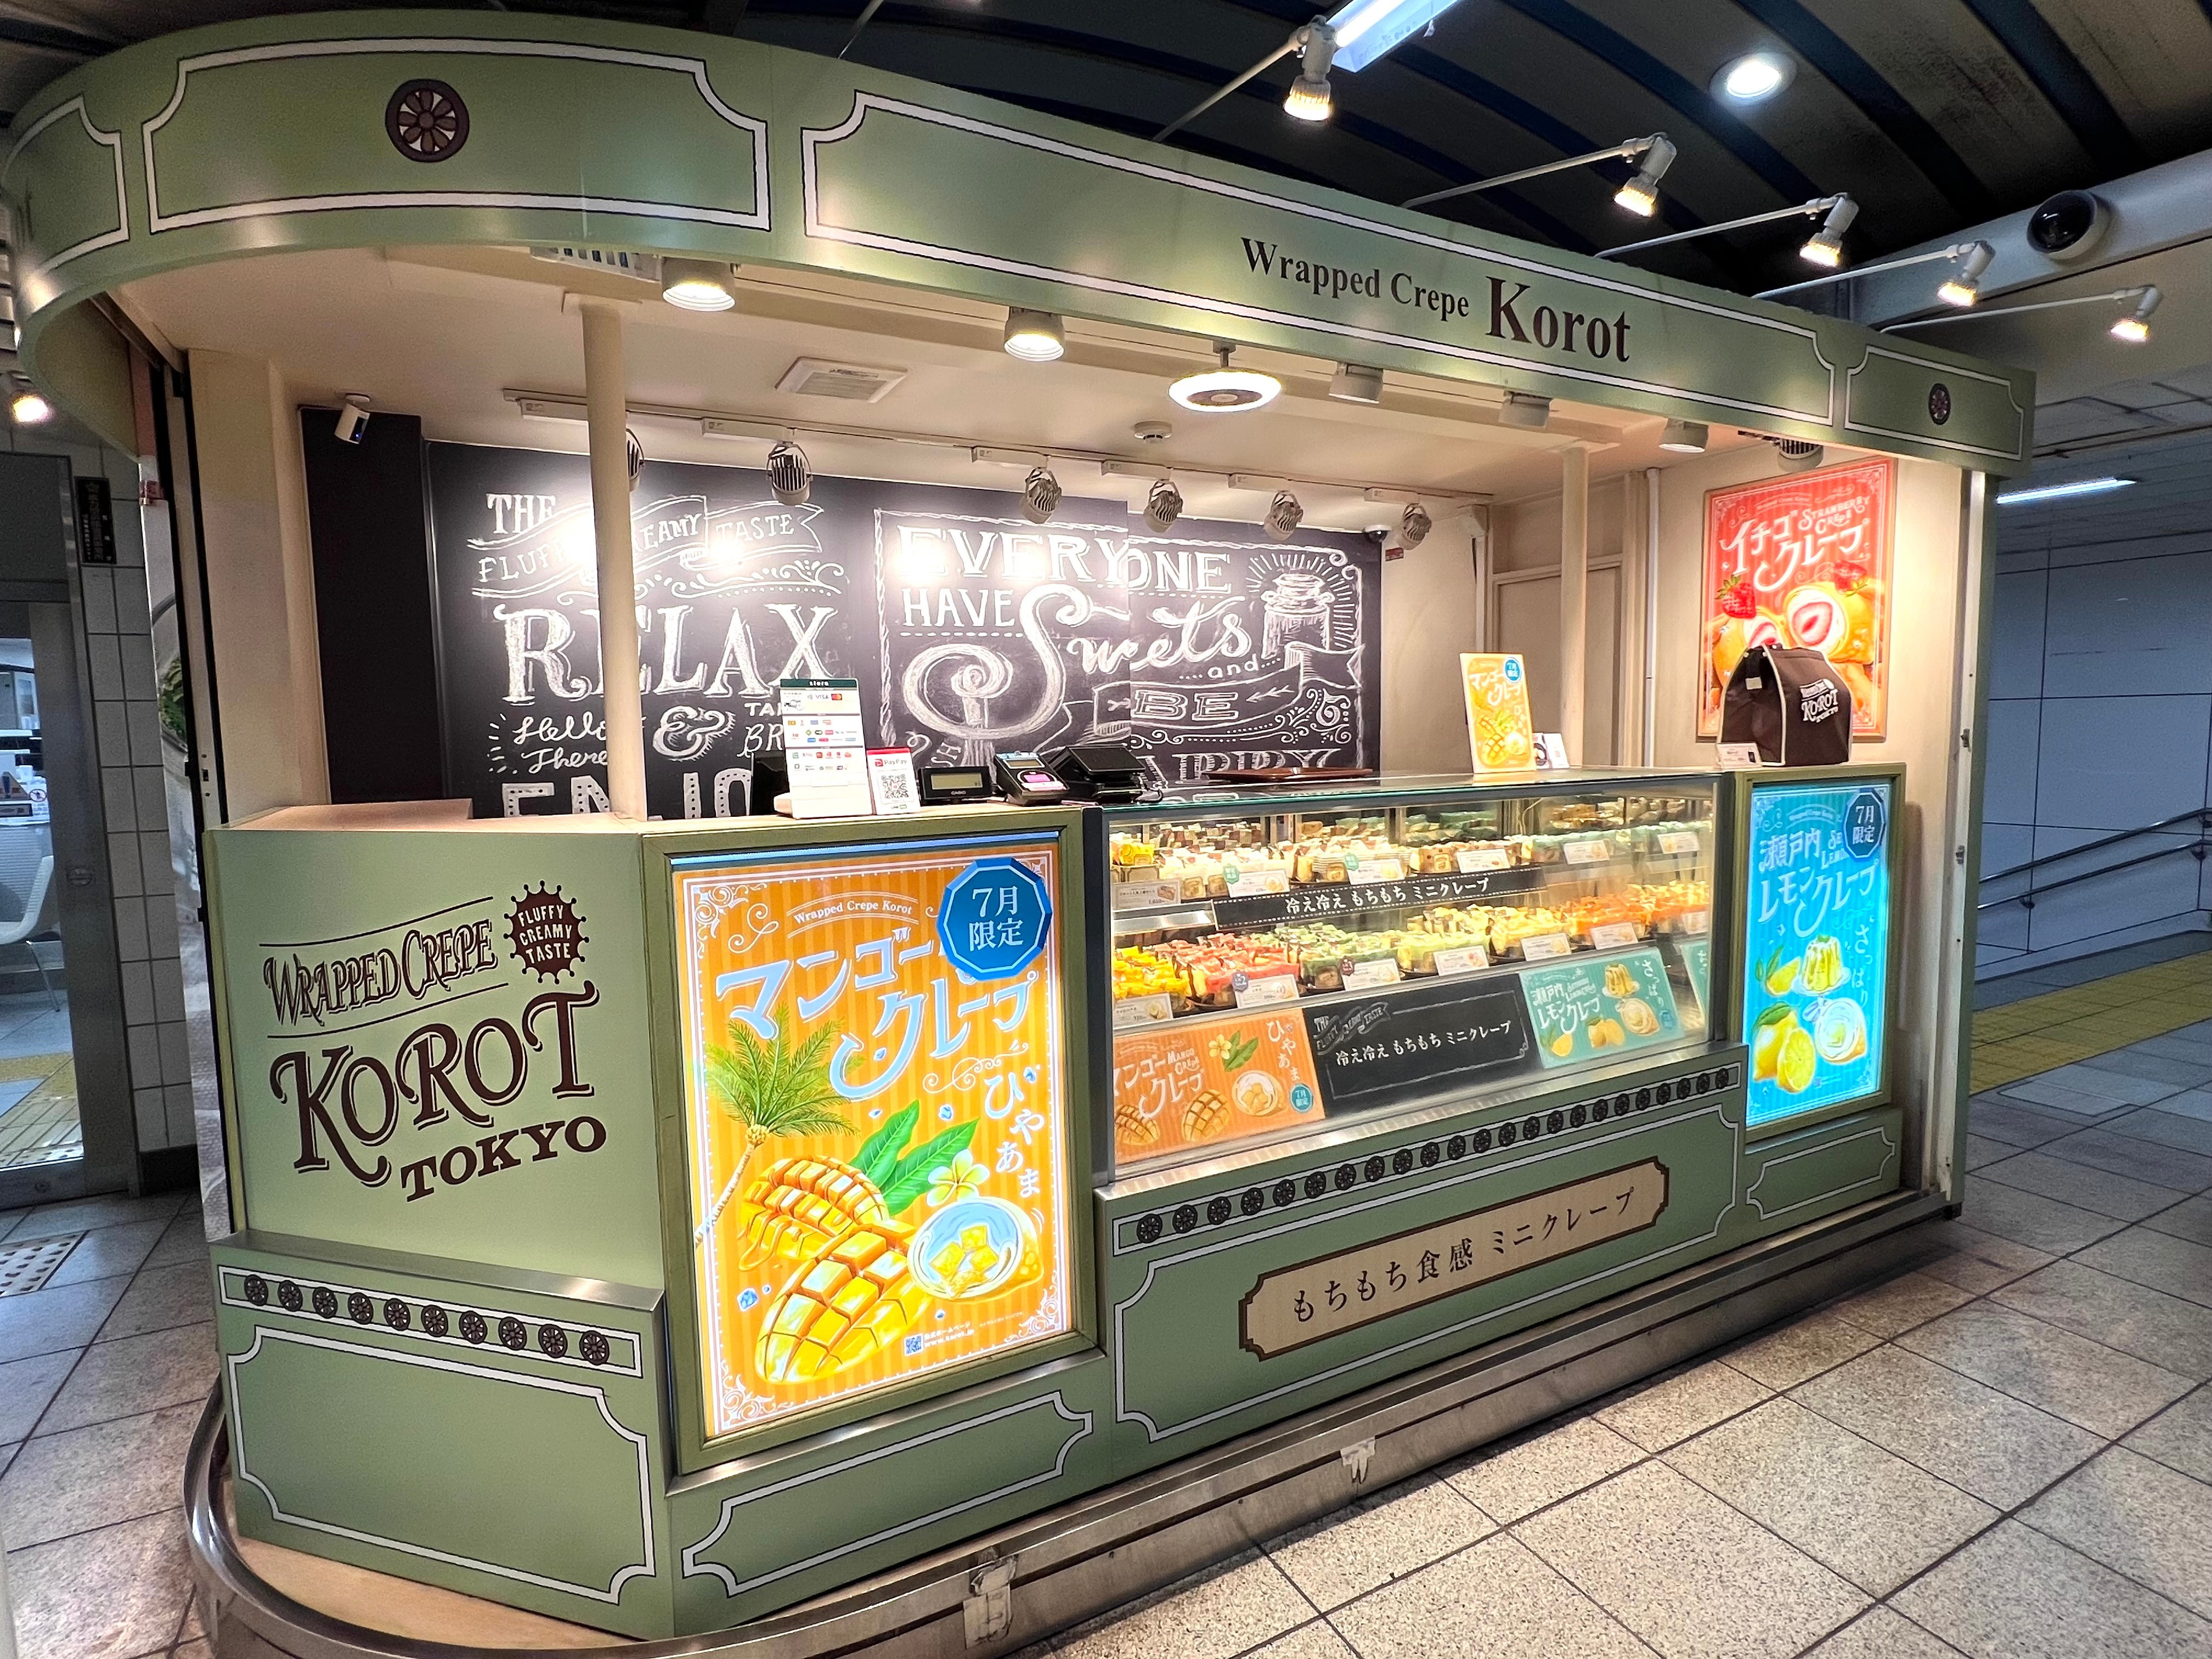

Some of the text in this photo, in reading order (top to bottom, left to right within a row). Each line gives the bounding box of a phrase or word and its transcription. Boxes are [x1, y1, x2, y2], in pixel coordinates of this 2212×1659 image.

[1240, 237, 1631, 362] Wrapped Crepe Korot
[1798, 495, 1870, 531] STRAWBERRY
[478, 513, 794, 583] FLUFF EAMY TASTE
[1719, 509, 1798, 577] イチゴ
[1754, 517, 1871, 592] クレープ
[900, 587, 1016, 628] HAVE
[902, 583, 1255, 742] Sweets
[1206, 657, 1259, 680] and
[1131, 688, 1240, 721] BE
[1801, 689, 1838, 722] KOROT
[1852, 825, 1876, 845] 限定
[1855, 805, 1875, 824] 7月
[1758, 827, 1821, 874] 瀬戸内
[517, 904, 565, 928] FLUFFY
[793, 899, 913, 925] Wrapped Crepe Korot
[972, 886, 1019, 918] 7月
[1286, 877, 1489, 915] 冷え冷え もちもち ミニクレープ
[1757, 859, 1880, 939] レモンクレープ
[518, 923, 573, 947] CREAMY
[525, 941, 572, 964] TASTE
[968, 918, 1024, 952] 限定
[263, 919, 499, 1026] WRAPPED CREPE
[715, 926, 934, 1041] マンゴー
[830, 970, 1040, 1102] クレープ
[1167, 1047, 1195, 1065] MANGO
[1335, 1020, 1511, 1066] 冷え冷え もちもち ミニクレープ
[269, 980, 600, 1188] KOROT
[1114, 1053, 1166, 1097] ンゴー
[1138, 1068, 1205, 1119] クレープ
[400, 1116, 607, 1203] TOKYO
[1293, 1186, 1636, 1323] もちもち食感 ミニクレープ
